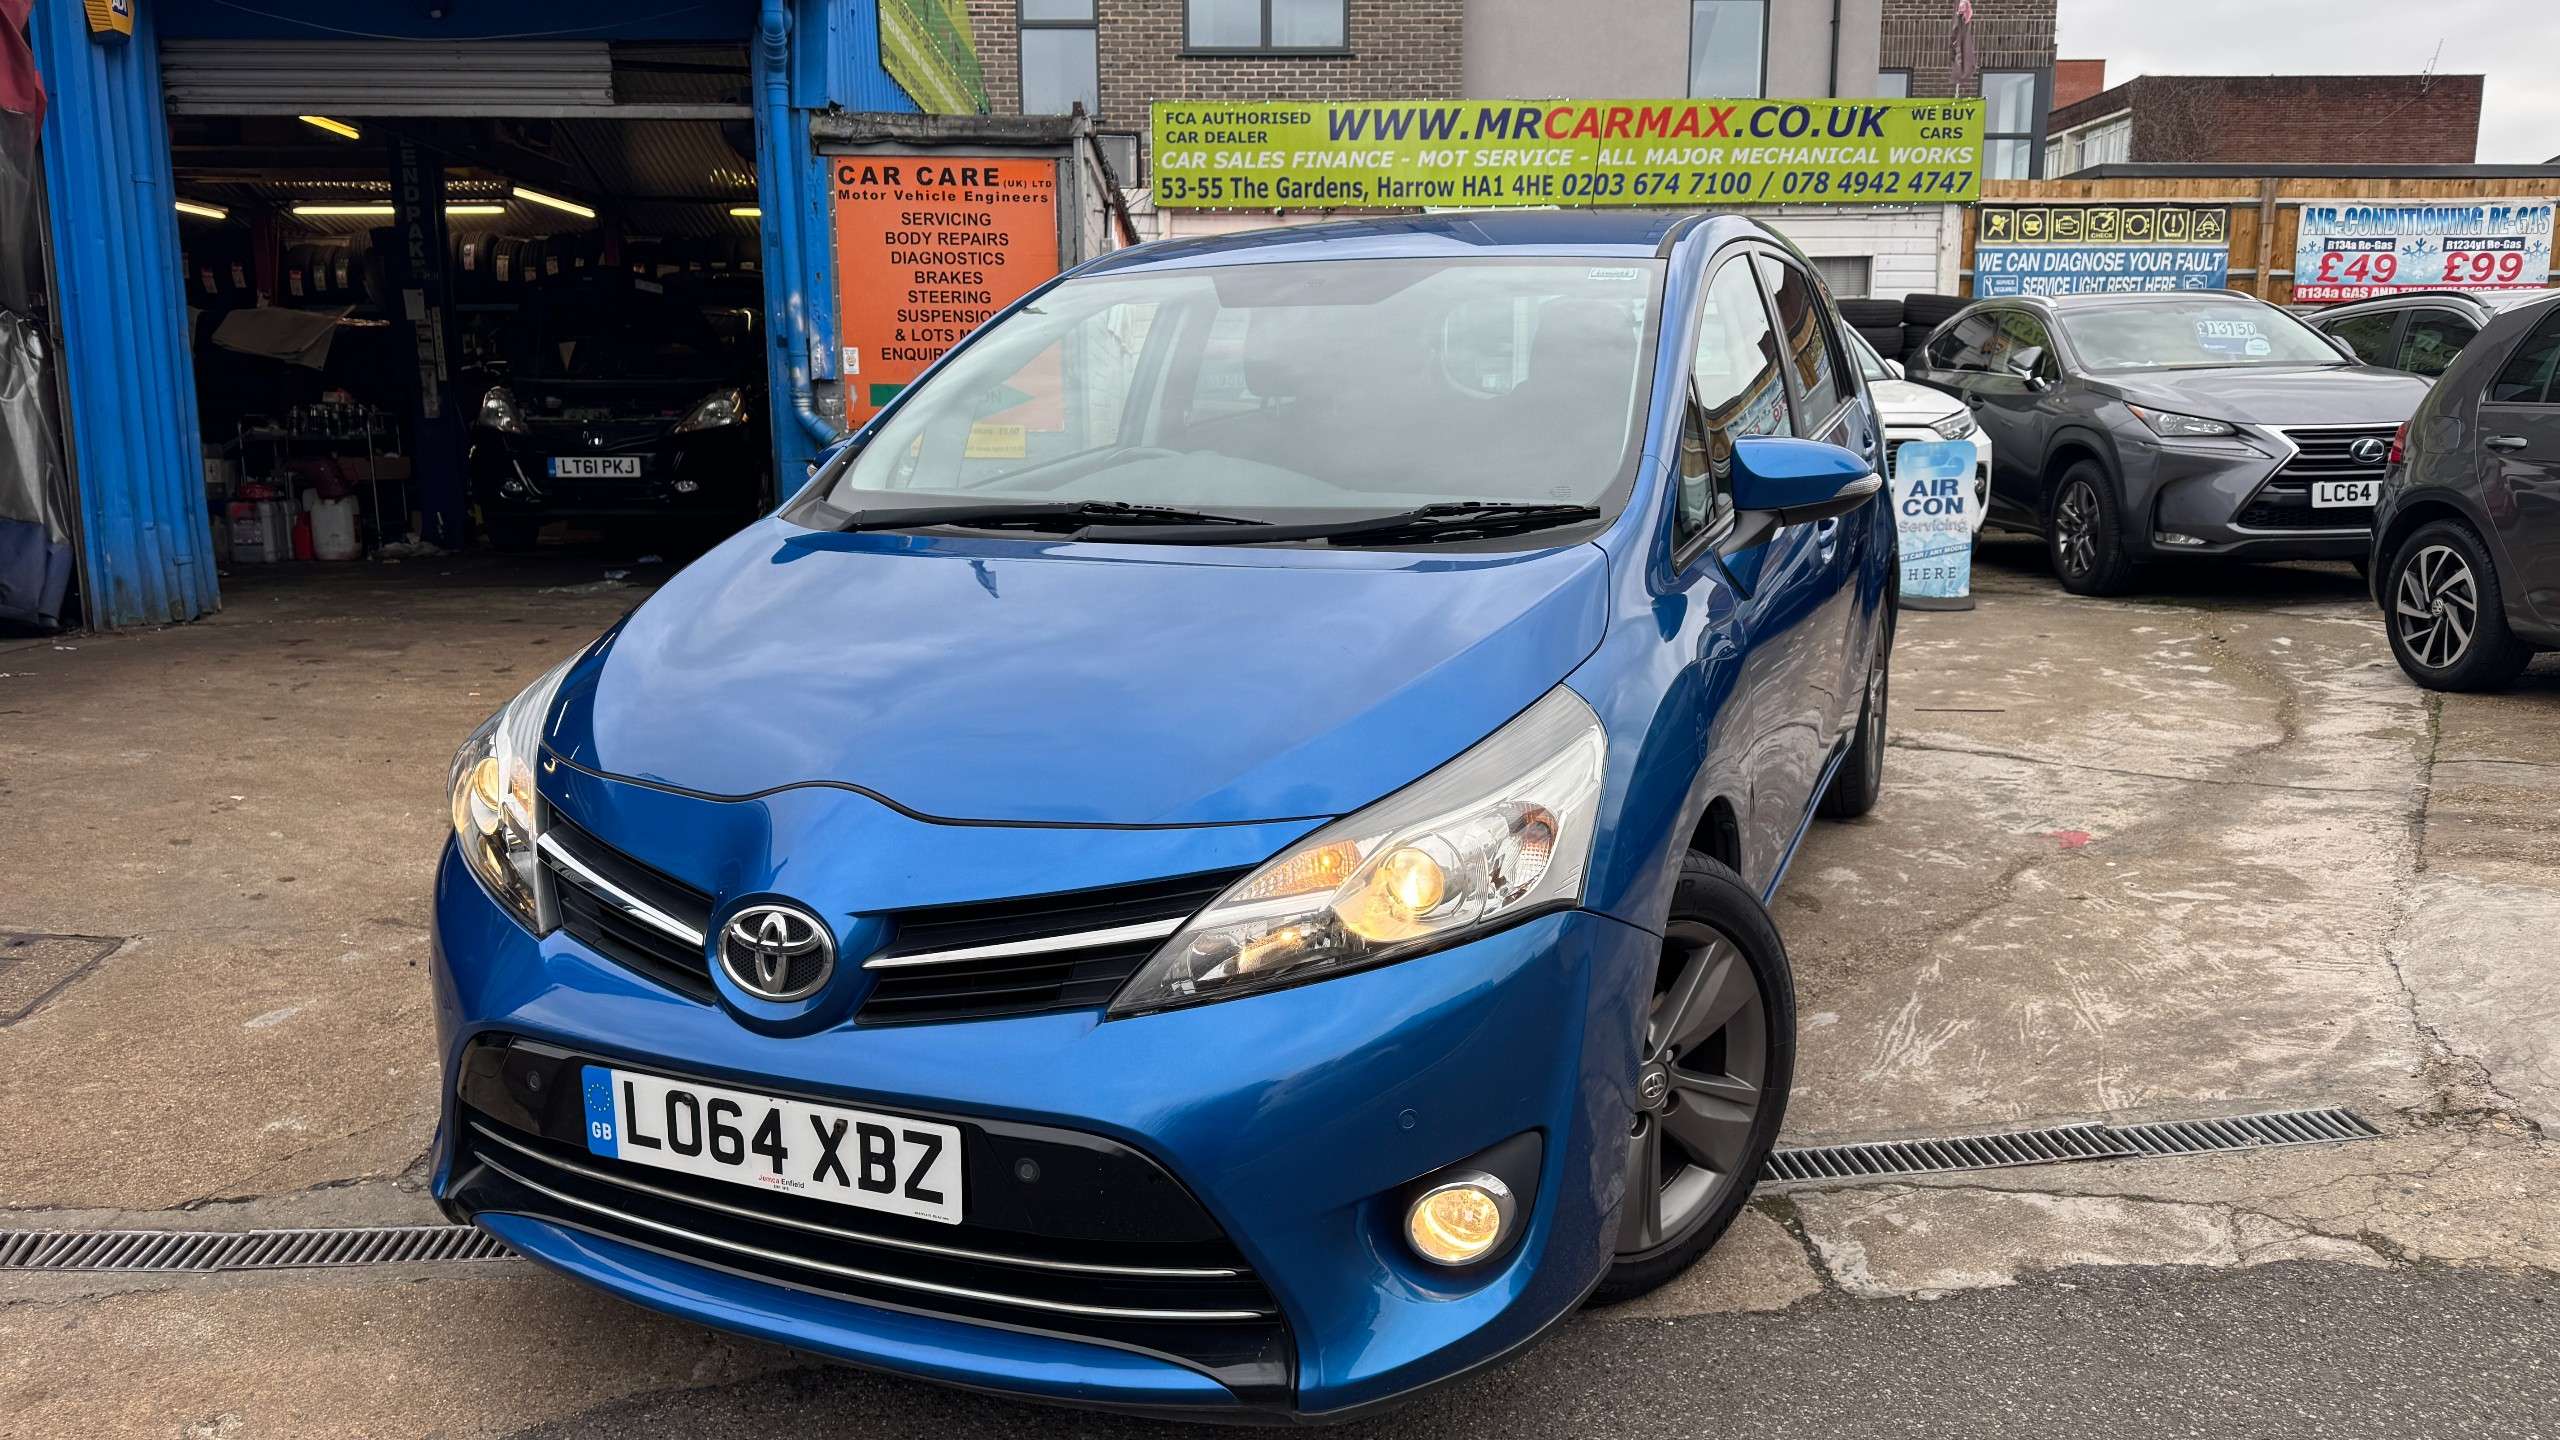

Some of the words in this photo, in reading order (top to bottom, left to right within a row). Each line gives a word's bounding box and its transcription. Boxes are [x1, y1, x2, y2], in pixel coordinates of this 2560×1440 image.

[1166, 112, 1197, 125] FCA
[1202, 112, 1312, 125] AUTHORISED
[1911, 108, 1939, 121] WE
[1942, 108, 1976, 120] BUY
[1328, 106, 1888, 141] WWW.MRCARMAX.CO.UK
[1166, 131, 1199, 144] CAR
[1205, 131, 1268, 144] DEALER
[1920, 127, 1963, 140] CARS
[1161, 151, 1207, 169] CAR
[1214, 151, 1285, 169] SALES
[1292, 150, 1395, 169] FINANCE
[1417, 149, 1469, 168] MOT
[1474, 148, 1576, 168] SERVICE
[1598, 148, 1637, 166] ALL
[1644, 148, 1723, 166] MAJOR
[1730, 147, 1880, 165] MECHANICAL
[1889, 146, 1974, 164] WORKS
[838, 165, 901, 186] CAR
[916, 166, 1000, 188] CARE
[1002, 179, 1028, 189] (UK)
[1032, 180, 1052, 188] LTD
[1161, 176, 1223, 200] 53-55
[1230, 176, 1269, 199] The
[1276, 176, 1369, 203] Gardens,
[1378, 176, 1455, 198] Harrow
[1462, 174, 1504, 198] HA1
[1512, 174, 1554, 197] 4HE
[1562, 172, 1625, 196] 0203
[1633, 172, 1680, 196] 674
[1688, 172, 1752, 196] 7100
[1758, 172, 1776, 200] /
[1782, 172, 1830, 195] 078
[1837, 171, 1900, 194] 4942
[1908, 171, 1974, 194] 4747
[838, 189, 886, 201] Motor
[894, 190, 957, 202] Vehicle
[964, 190, 1049, 205] Engineers
[900, 212, 992, 226] SERVICING
[2303, 206, 2484, 237] AIR-CONDITIONING
[2487, 205, 2551, 236] RE-GAS
[885, 231, 932, 246] BODY
[938, 232, 1009, 246] REPAIRS
[2327, 240, 2356, 250] R134a
[2358, 240, 2394, 250] Re-Gas
[2446, 240, 2486, 251] R1234yf
[2487, 239, 2522, 249] Re-Gas
[891, 251, 1005, 266] DIAGNOSTICS
[1978, 252, 2004, 272] WE
[2006, 252, 2046, 272] CAN
[2048, 252, 2127, 272] DIAGNOSE
[2130, 252, 2174, 272] YOUR
[2176, 252, 2221, 272] FAULT
[2316, 252, 2398, 283] £49
[2441, 252, 2524, 283] £99
[914, 270, 984, 285] BRAKES
[2022, 276, 2070, 296] SERVICE
[2072, 276, 2106, 295] LIGHT
[2107, 276, 2145, 293] RESET
[2146, 276, 2176, 291] HERE
[2296, 285, 2340, 300] R134a
[2342, 286, 2369, 299] GAS
[908, 290, 992, 304] STEERING
[897, 310, 998, 323] SUSPENSIO
[895, 328, 906, 342] &
[912, 328, 954, 342] LOTS
[882, 348, 948, 361] ENQUIR
[561, 459, 598, 474] LT61
[602, 459, 635, 474] PKJ
[1908, 478, 1959, 498] AIR
[2320, 484, 2372, 502] LC64
[1902, 497, 1964, 516] CON
[1898, 518, 1968, 534] Servicing
[1908, 566, 1957, 580] HERE
[591, 1121, 613, 1141] GB
[623, 1080, 789, 1176] LO64
[809, 1113, 944, 1205] XBZ
[781, 1178, 805, 1189] Enfield
